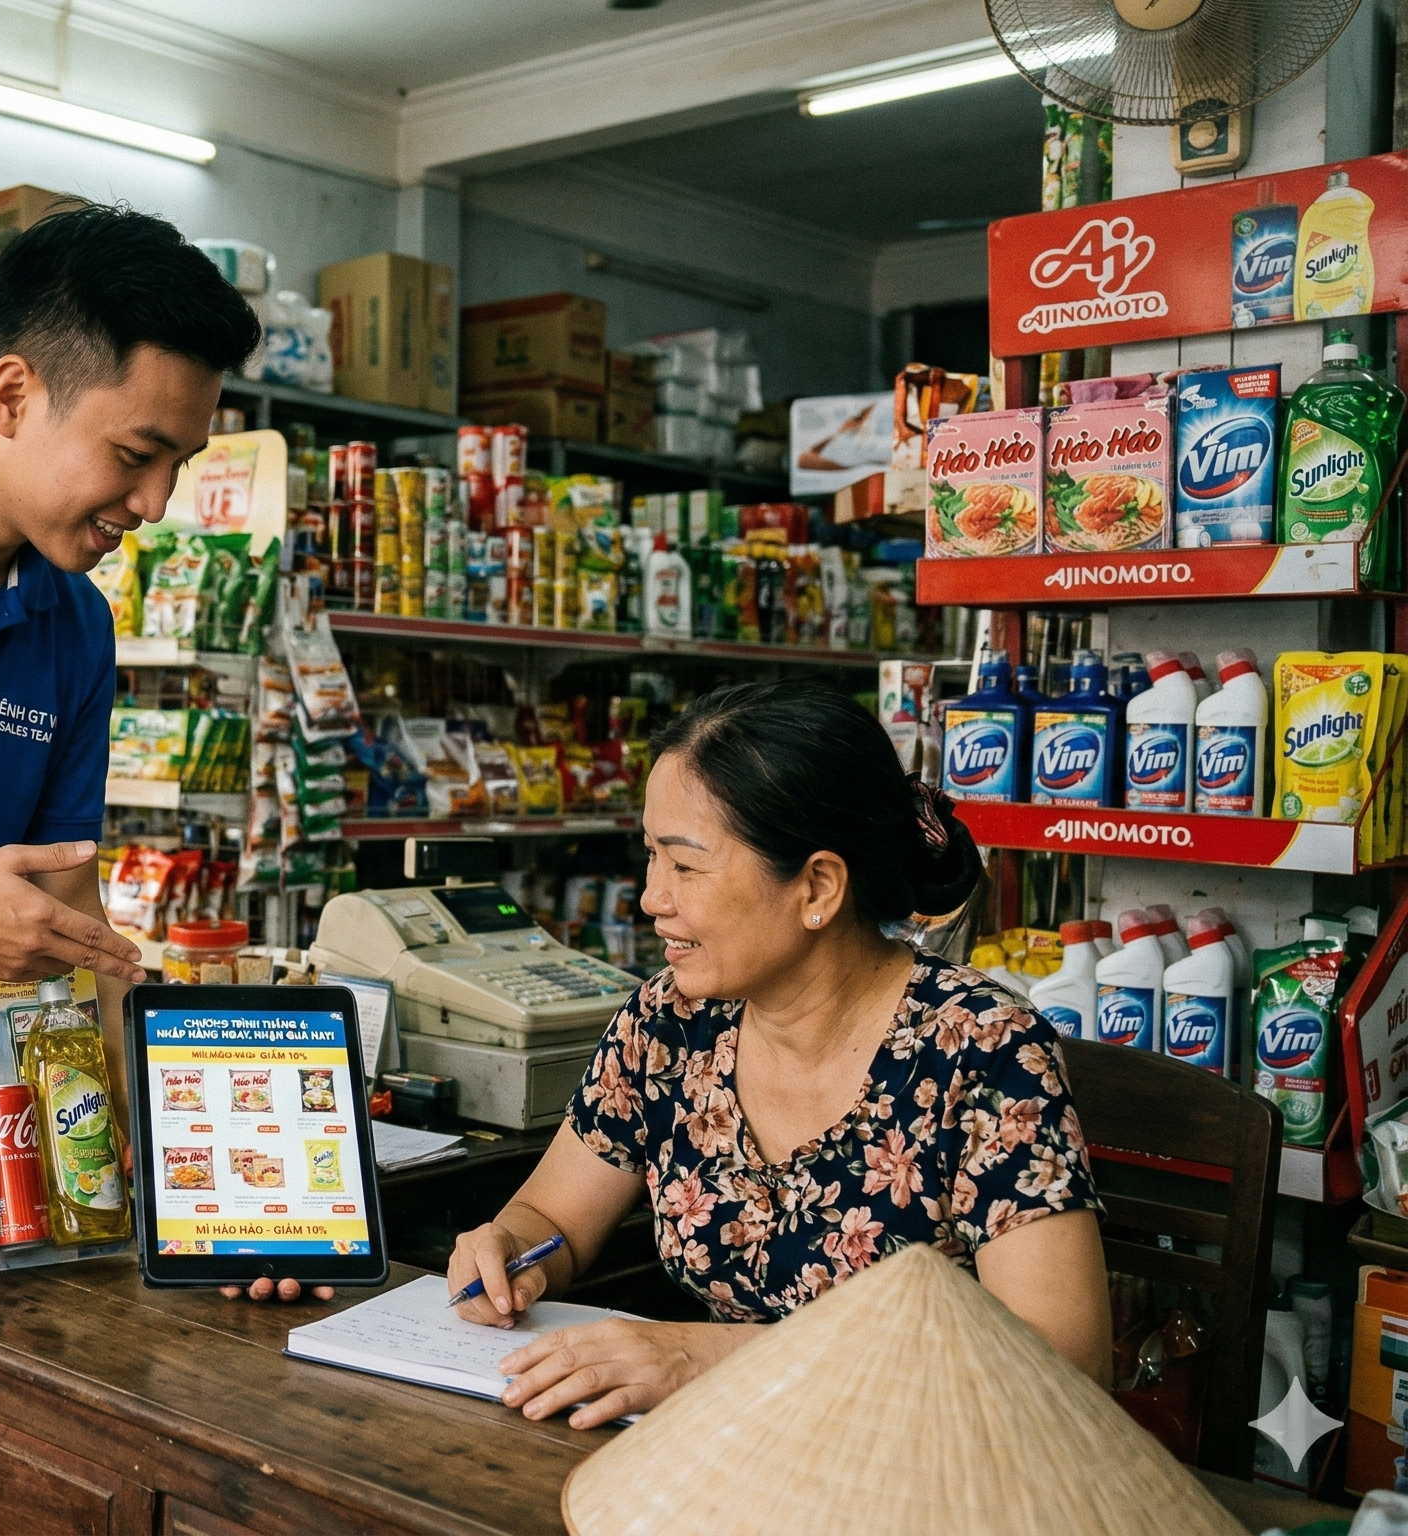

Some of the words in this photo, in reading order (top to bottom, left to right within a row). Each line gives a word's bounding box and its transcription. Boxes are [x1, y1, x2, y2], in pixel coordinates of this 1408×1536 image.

[1240, 253, 1292, 283] Vim
[932, 442, 980, 479] Hảo
[984, 431, 1036, 470] Hảo
[1051, 430, 1104, 468] Hảo
[1107, 420, 1162, 458] Hảo
[1190, 442, 1264, 483] Vim
[1290, 450, 1366, 498] Sunlight
[28, 709, 48, 726] GT
[1283, 711, 1364, 758] Sunlight
[952, 742, 1005, 772] Vim
[1042, 745, 1096, 775] Vim
[1132, 749, 1177, 774] Vim
[1201, 751, 1245, 777] Vim
[1100, 1012, 1143, 1034] Vim
[1167, 1019, 1216, 1044] Vim
[1263, 1026, 1318, 1054] Vim
[306, 1225, 328, 1235] 10%
